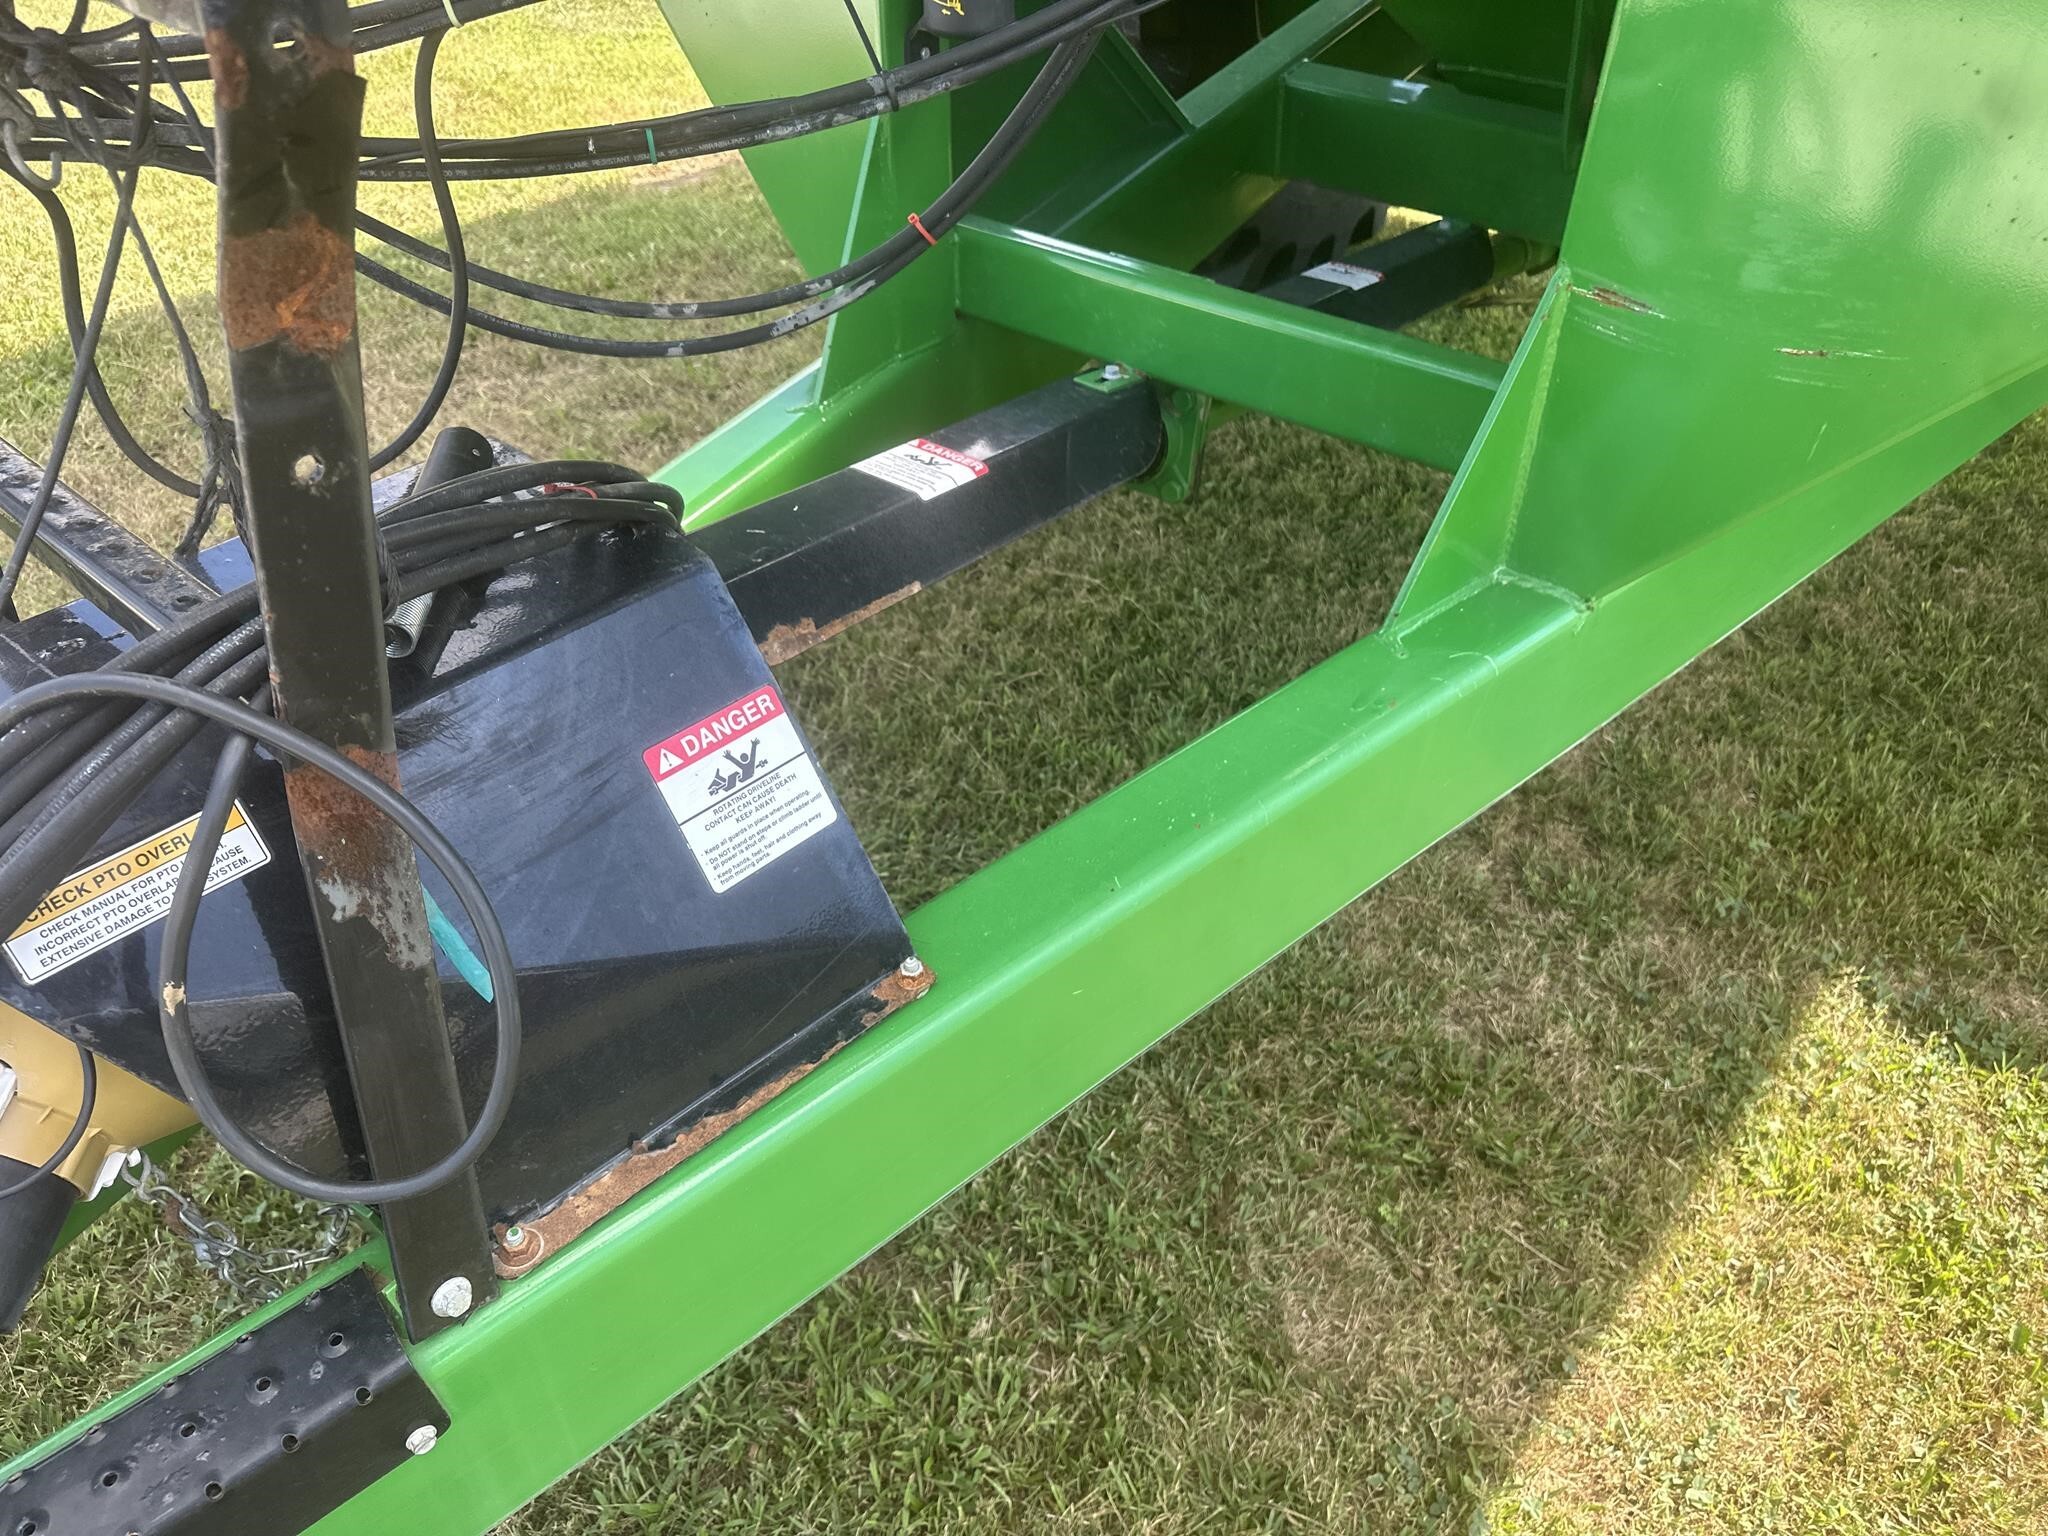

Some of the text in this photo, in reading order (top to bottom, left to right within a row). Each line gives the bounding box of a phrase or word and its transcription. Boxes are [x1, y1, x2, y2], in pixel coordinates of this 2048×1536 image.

[922, 443, 984, 472] DANGER
[679, 692, 775, 757] DANGER
[704, 772, 797, 831] CONTACT CAN CAUSE DEATH
[712, 771, 781, 815] ROTATING DRIVELINE
[735, 795, 776, 823] KEEP AWAY!
[704, 843, 720, 855] Keep
[719, 838, 727, 846] all
[727, 826, 747, 842] guards
[753, 813, 769, 826] place
[768, 804, 784, 816] when
[708, 855, 718, 864] Do
[718, 847, 731, 858] NOT
[731, 837, 747, 850] stand
[747, 832, 756, 841] on
[755, 823, 772, 837] steps
[777, 809, 793, 822] climb
[792, 799, 810, 813] ladder
[809, 791, 822, 802] until
[712, 862, 720, 870] all
[719, 851, 738, 866] power
[743, 839, 757, 850] shut
[717, 867, 732, 880] Keep
[764, 840, 775, 850] hair
[775, 833, 786, 843] and
[785, 819, 808, 837] clothing
[807, 811, 822, 824] away
[34, 915, 103, 956] INCORRECT
[101, 903, 128, 921] PTO
[208, 844, 244, 867] AUSE
[90, 861, 134, 888] PTO
[720, 873, 734, 885] from
[734, 860, 755, 877] moving
[39, 863, 180, 939] CHECK MANUAL FOR PTO
[40, 854, 252, 967] EXTENSIVE DAMAGE TO SYSTEM.
